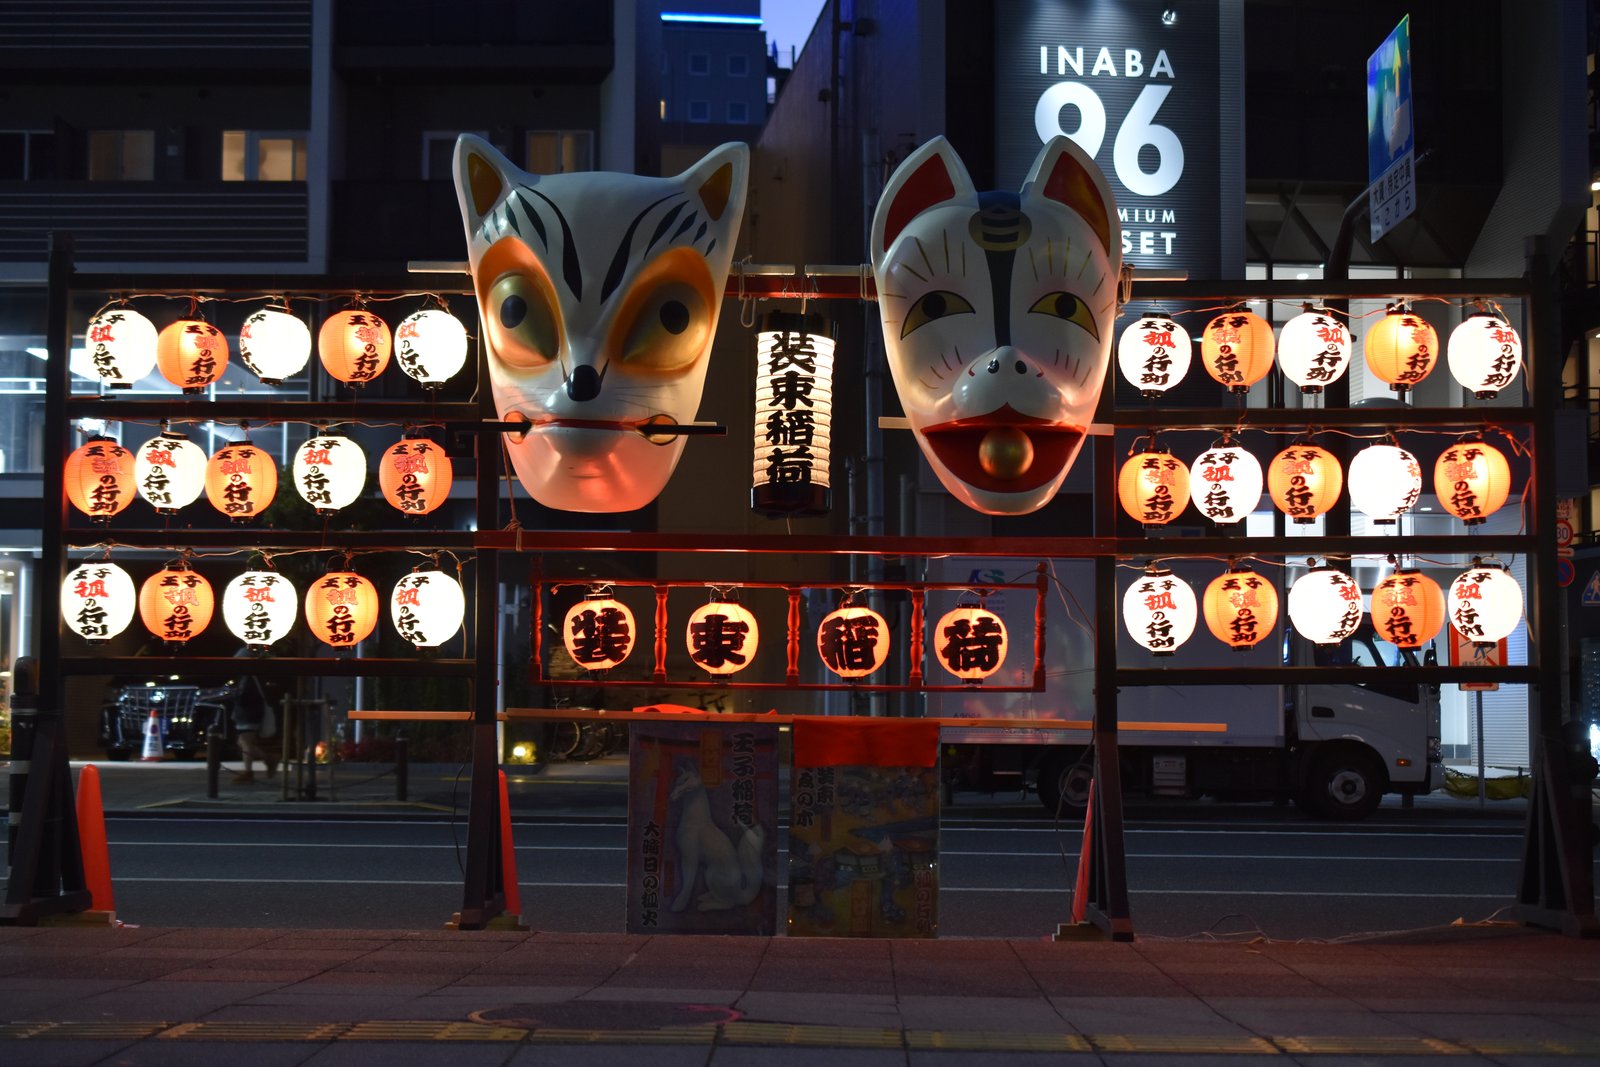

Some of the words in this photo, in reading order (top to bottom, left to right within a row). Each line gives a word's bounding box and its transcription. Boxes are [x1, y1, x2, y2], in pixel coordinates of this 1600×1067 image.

[1040, 46, 1175, 78] INABA
[1034, 81, 1184, 196] 96
[1117, 208, 1176, 223] MIUM
[1121, 231, 1177, 254] SET
[732, 732, 755, 829] 王子稲荷
